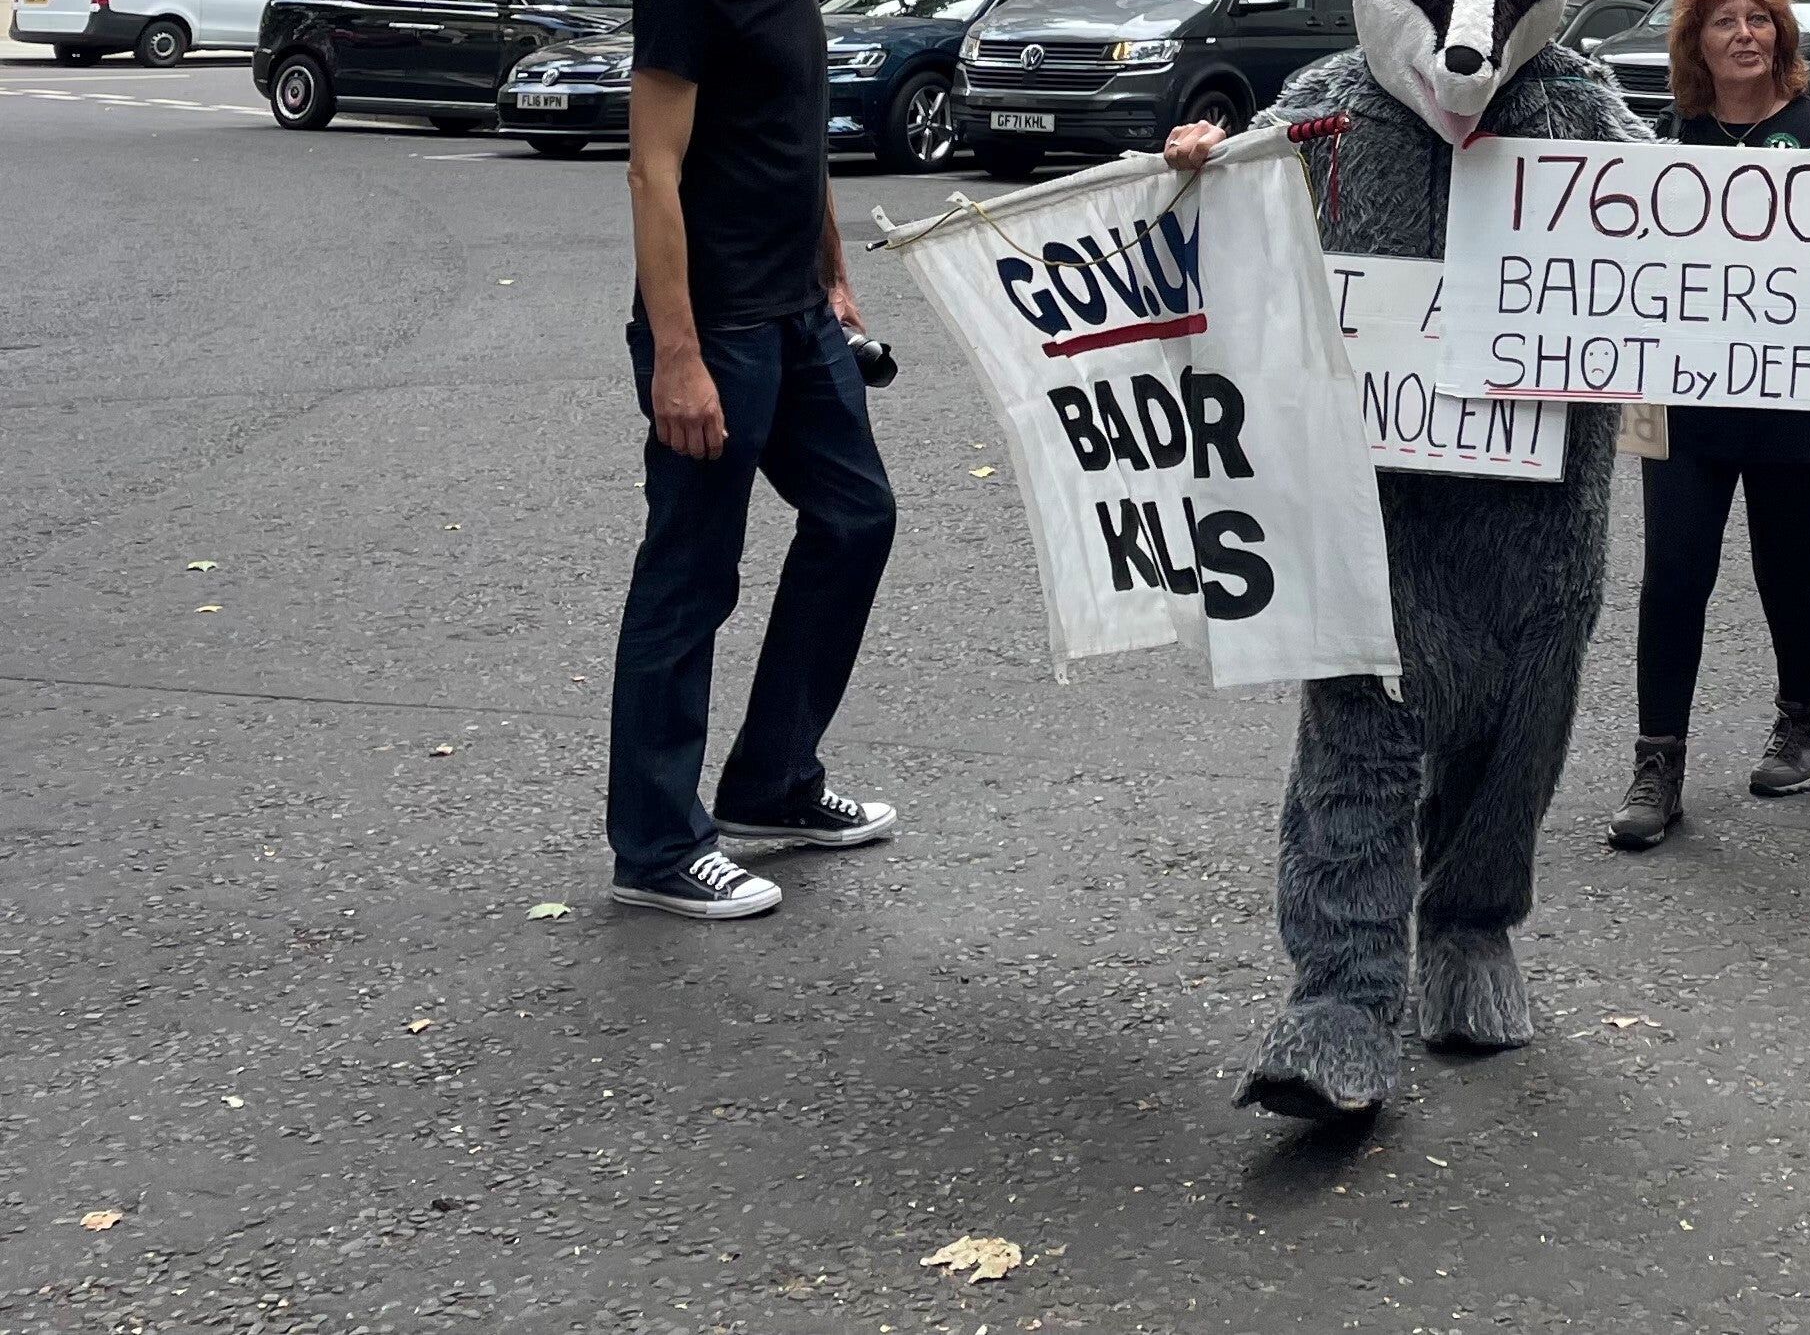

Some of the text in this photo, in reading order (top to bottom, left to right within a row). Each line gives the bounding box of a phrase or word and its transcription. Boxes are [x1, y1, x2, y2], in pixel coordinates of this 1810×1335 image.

[521, 94, 562, 108] FL16 WPN
[997, 114, 1047, 130] GF71 KHL
[1498, 255, 1799, 325] BADGERS
[1483, 332, 1661, 393] SHOT
[1672, 354, 1718, 401] by
